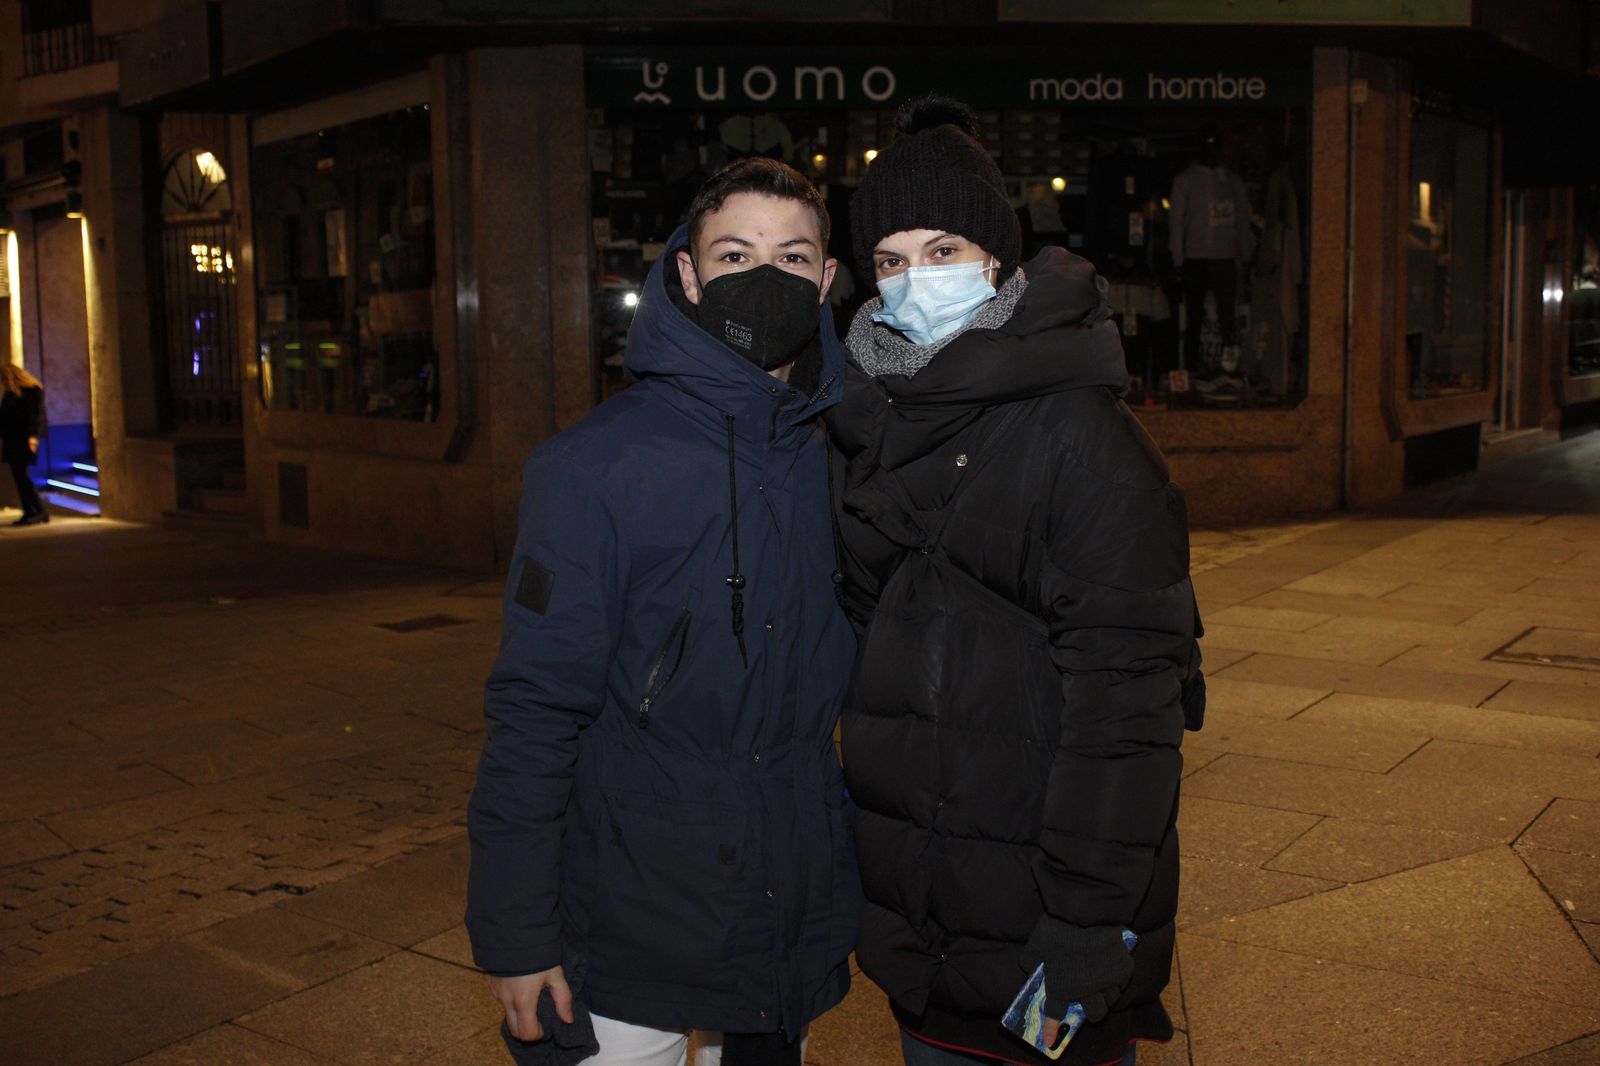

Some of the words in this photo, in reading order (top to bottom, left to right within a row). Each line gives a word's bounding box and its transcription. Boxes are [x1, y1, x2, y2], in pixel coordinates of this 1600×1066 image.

[695, 65, 897, 102] uomo
[1029, 73, 1124, 101] moda
[1147, 73, 1266, 100] hombre
